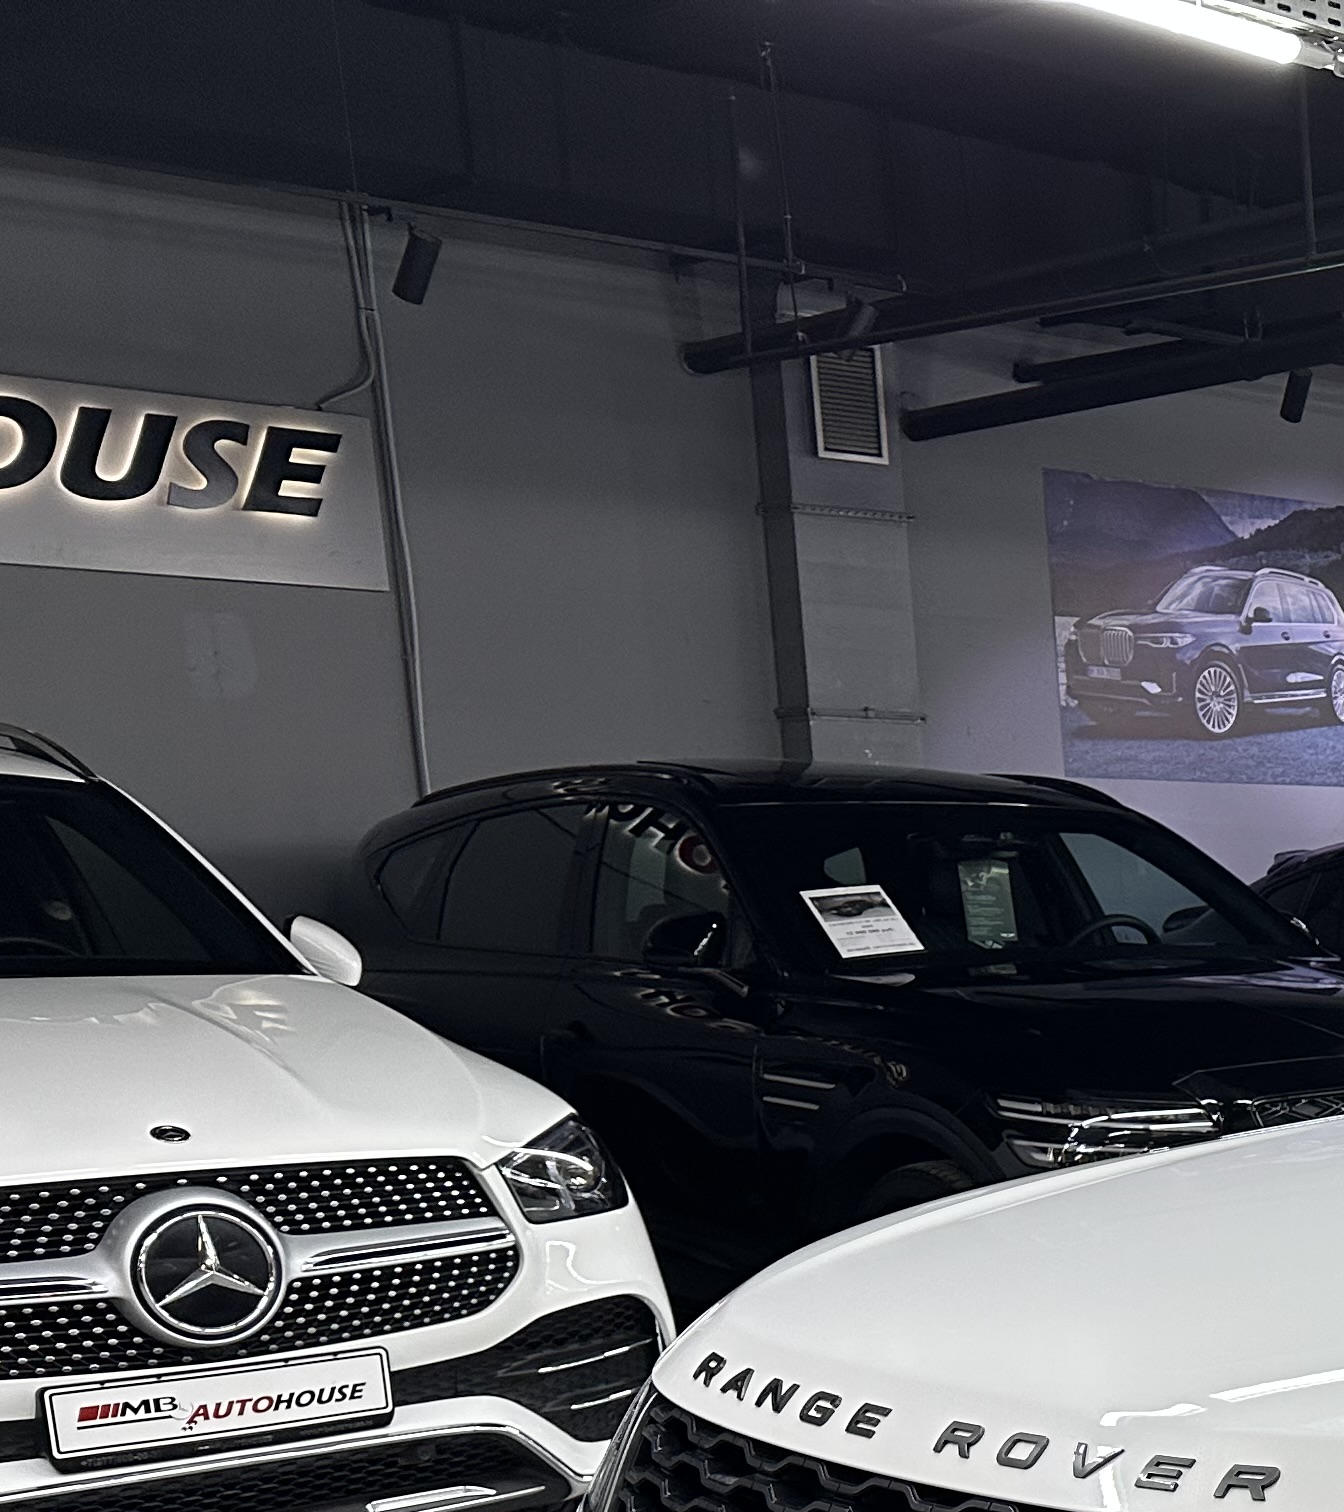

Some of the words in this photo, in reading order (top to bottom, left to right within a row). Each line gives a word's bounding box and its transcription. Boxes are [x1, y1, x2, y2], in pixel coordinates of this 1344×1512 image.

[187, 1381, 367, 1425] AUTOHOUSE
[692, 1350, 893, 1440] RANGE
[932, 1420, 1283, 1503] ROVER
